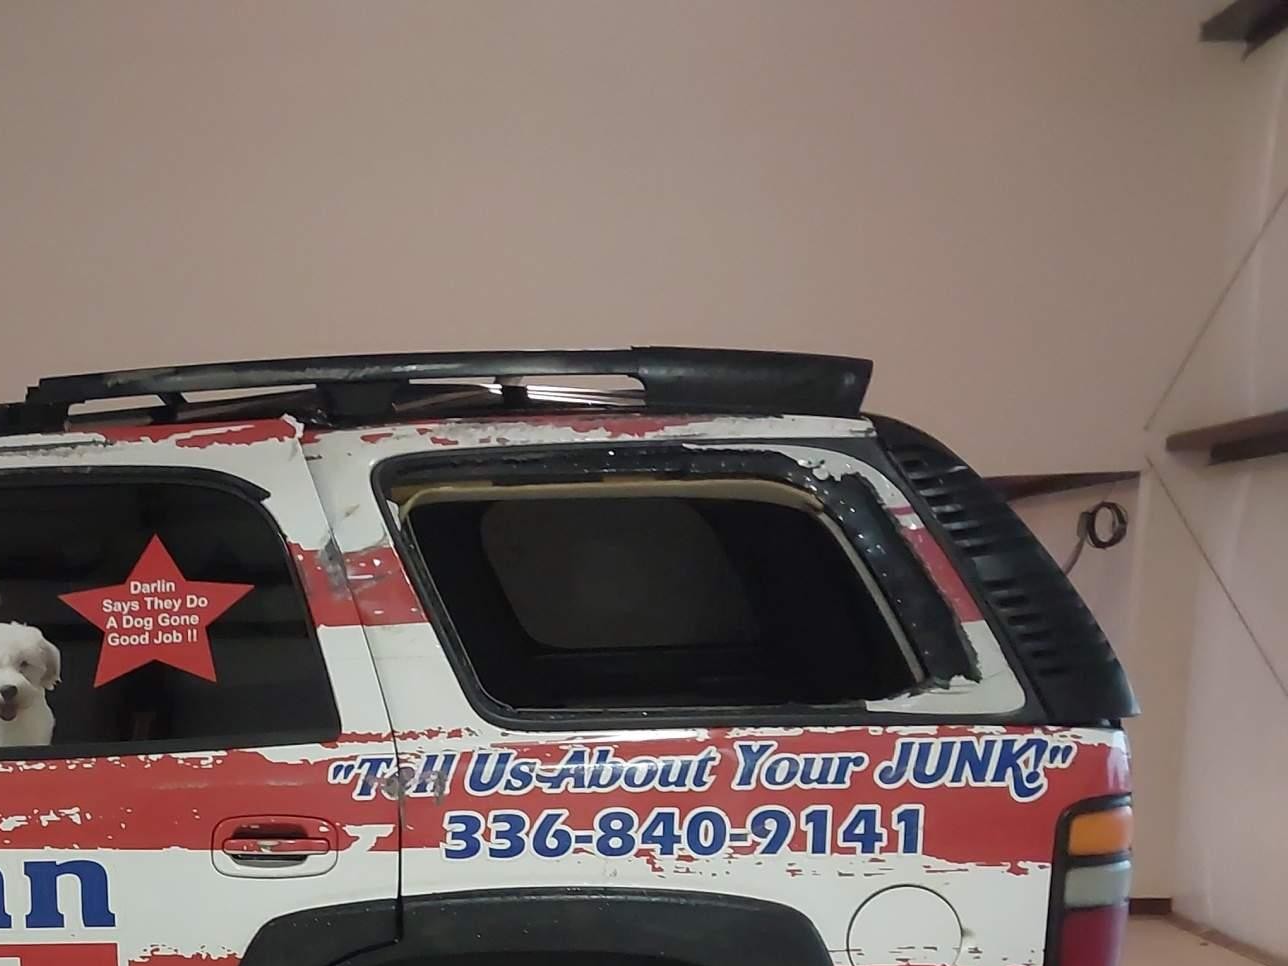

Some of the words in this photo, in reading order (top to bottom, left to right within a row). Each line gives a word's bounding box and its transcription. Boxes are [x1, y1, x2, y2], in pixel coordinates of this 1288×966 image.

[130, 579, 176, 595] Darlin
[102, 599, 140, 615] Says
[144, 596, 182, 612] They
[186, 595, 209, 609] Do
[106, 616, 118, 629] A
[122, 615, 153, 630] Dog
[158, 613, 200, 627] Gone
[108, 631, 150, 646] Good
[153, 629, 183, 644] Job
[468, 751, 537, 792] Us
[536, 749, 717, 791] About
[735, 742, 866, 787] Your
[878, 738, 1073, 798] JUNK!"
[445, 808, 923, 860] 336-840-9141
